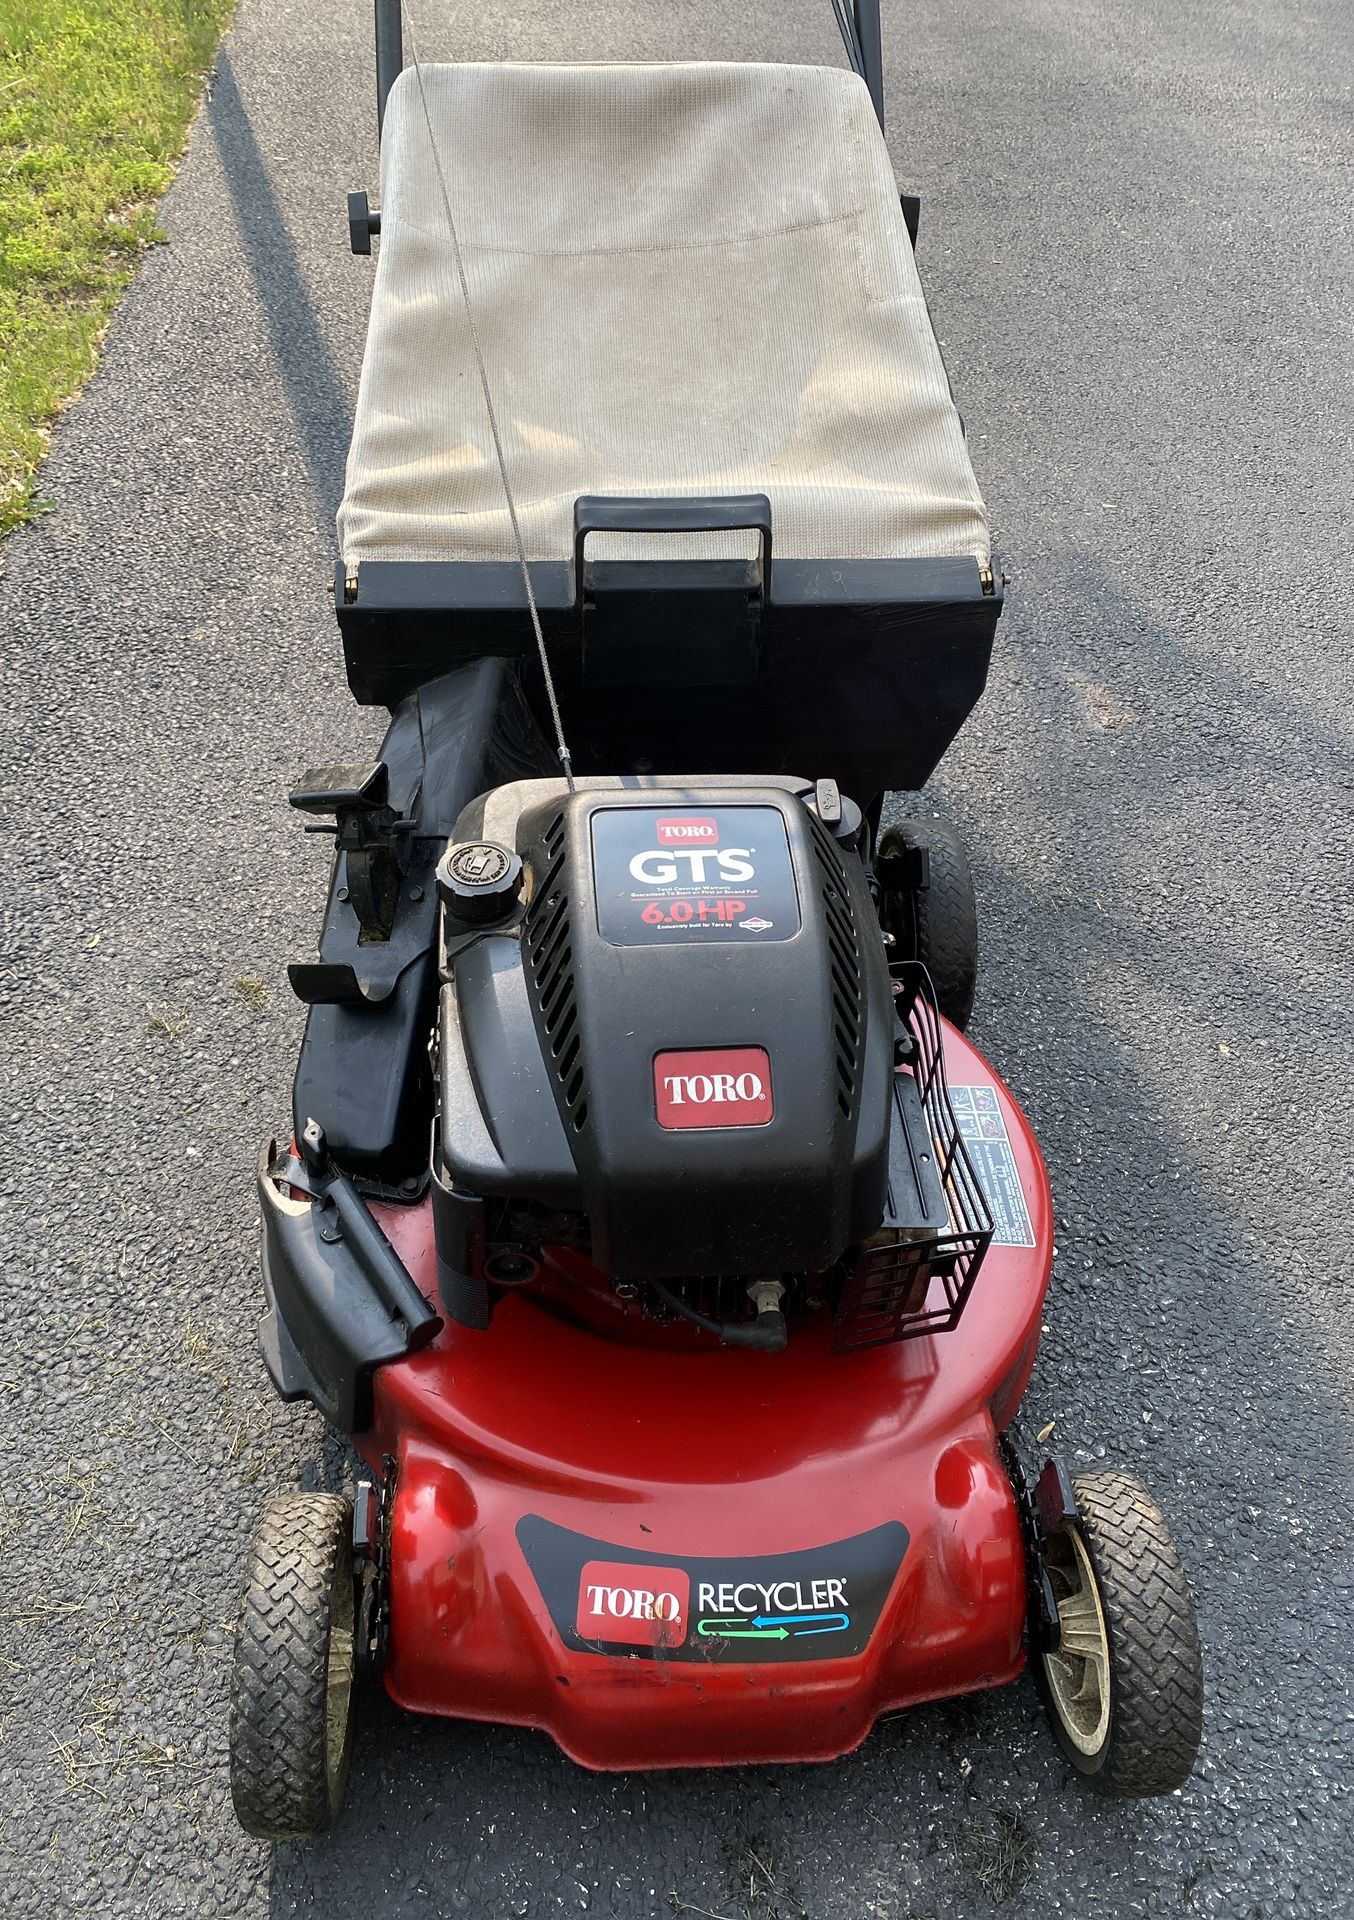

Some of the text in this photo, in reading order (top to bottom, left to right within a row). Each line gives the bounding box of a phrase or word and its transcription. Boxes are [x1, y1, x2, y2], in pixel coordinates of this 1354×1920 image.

[661, 826, 715, 837] TORO
[629, 848, 756, 884] GTS
[642, 900, 746, 924] 6.0 HP
[664, 1072, 765, 1104] TORO
[587, 1577, 849, 1623] TORO RECYCLER
